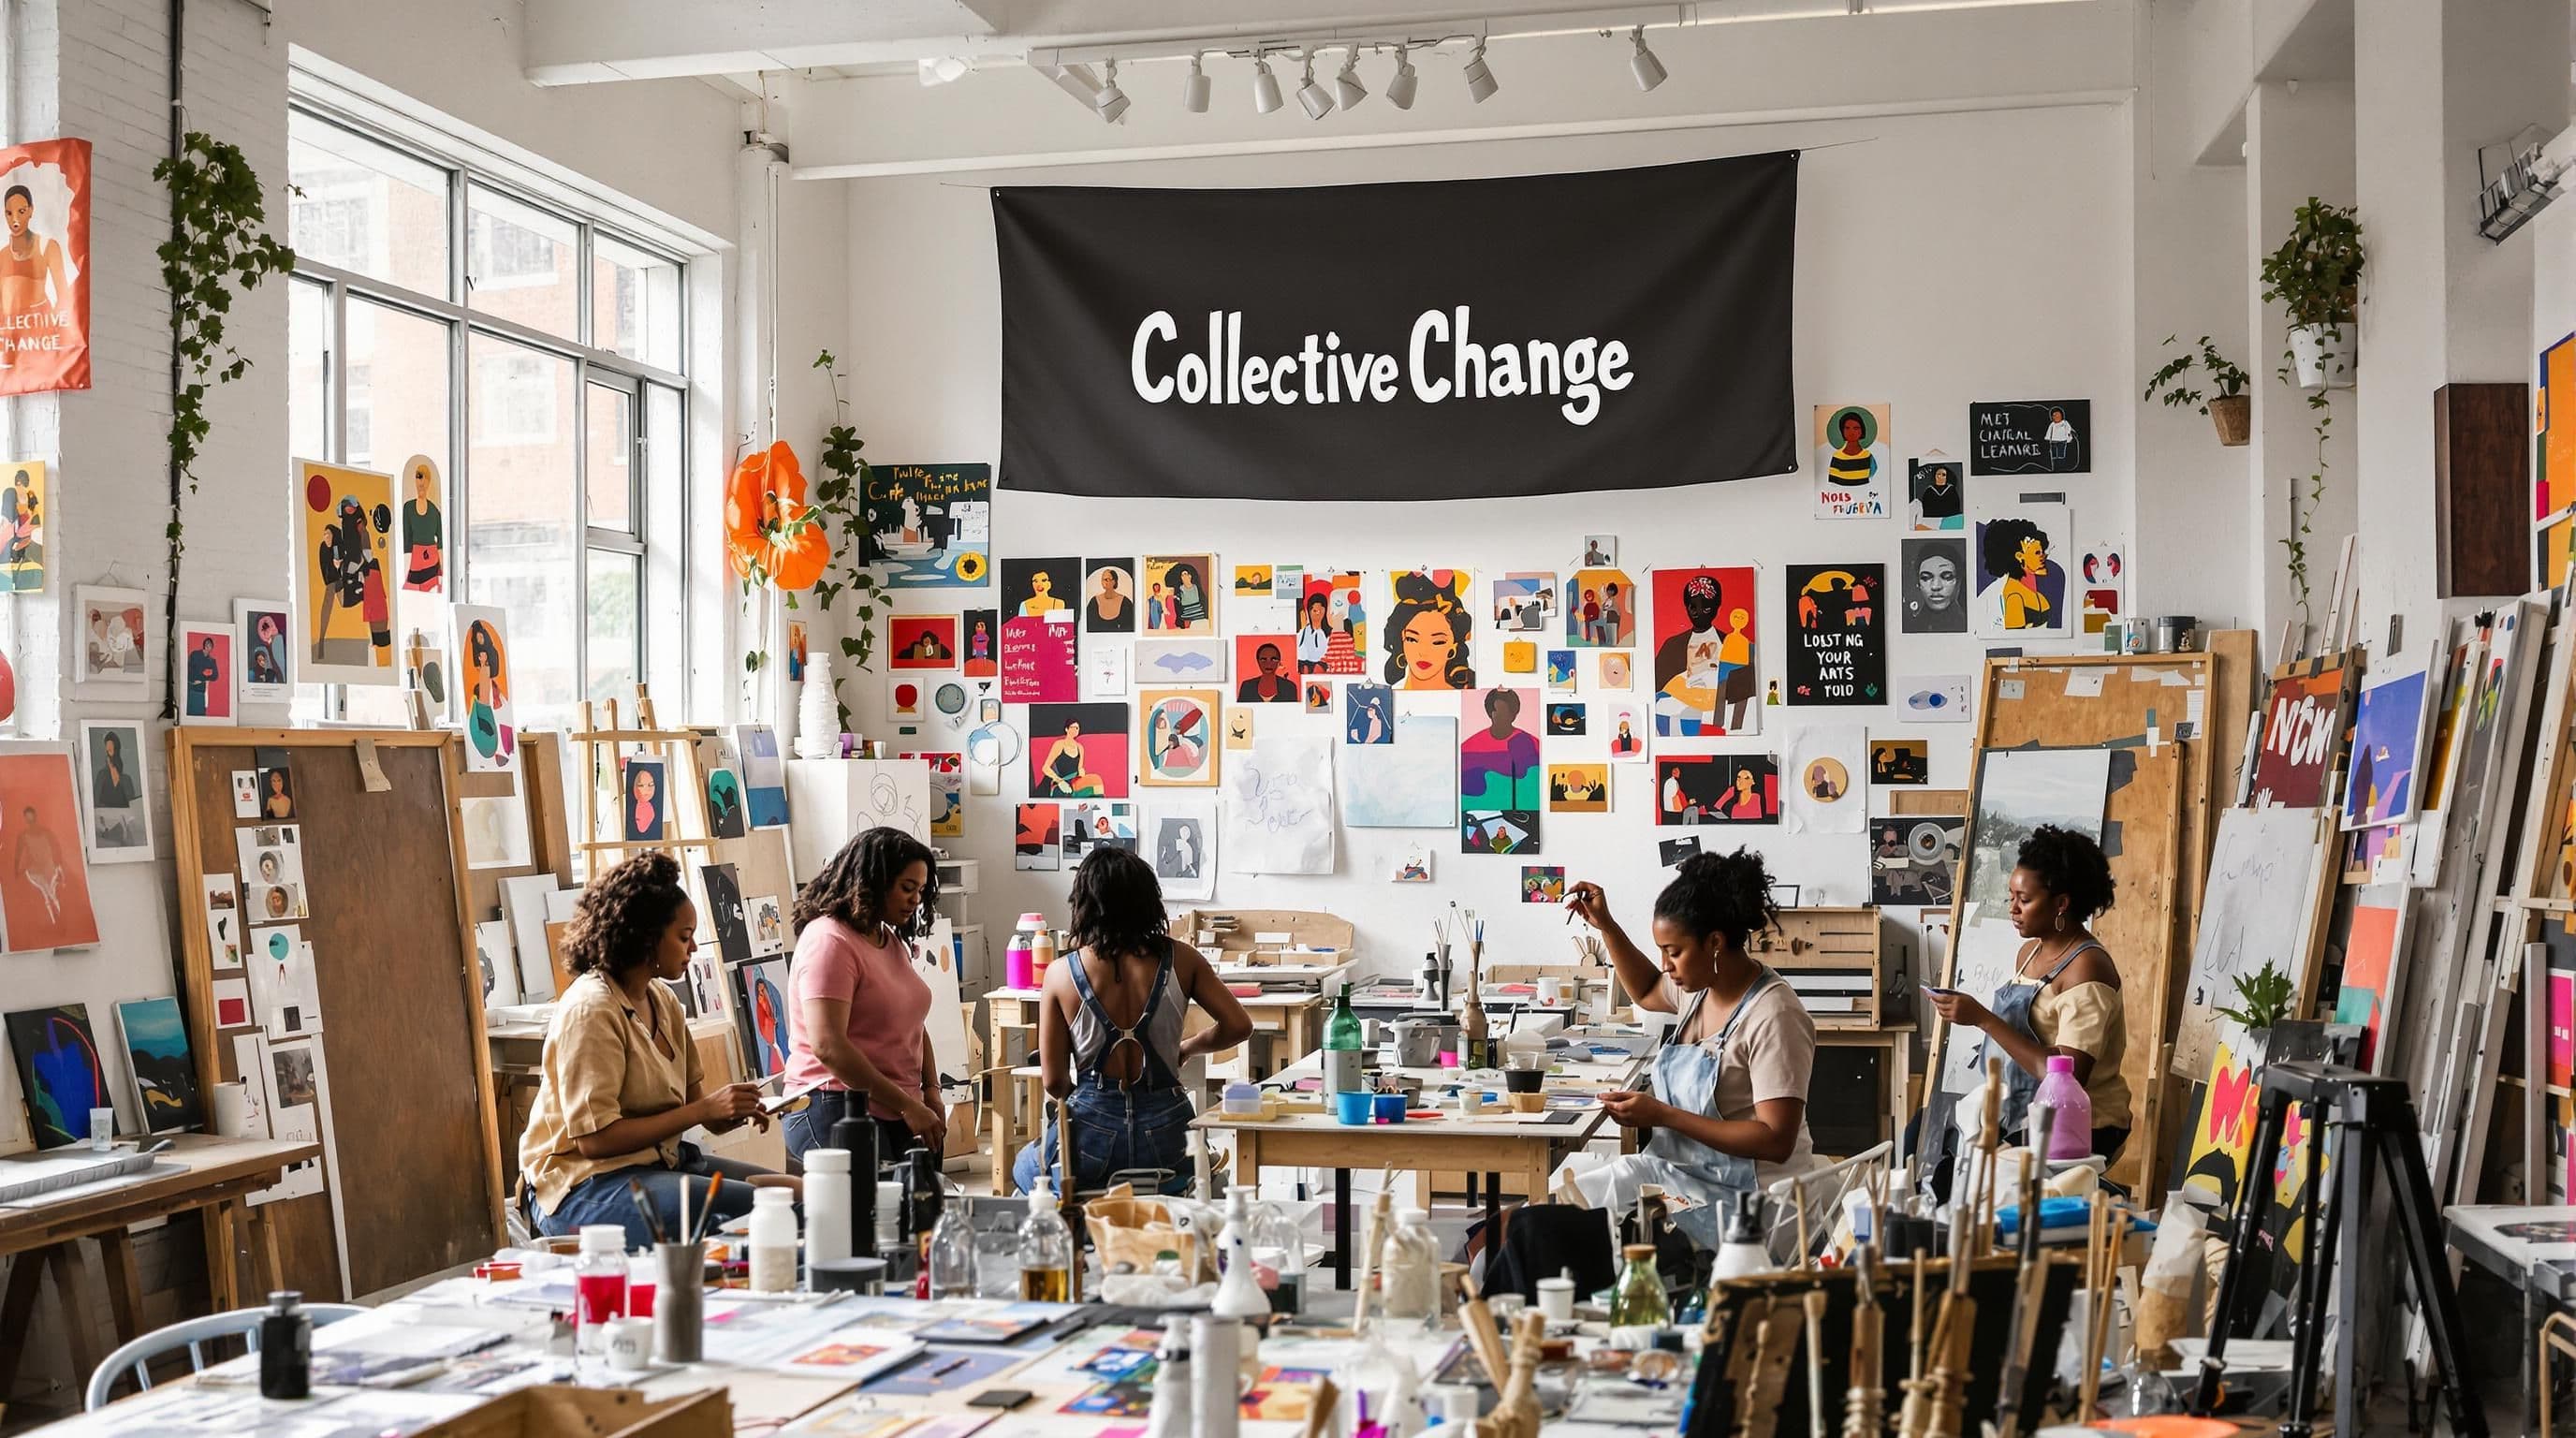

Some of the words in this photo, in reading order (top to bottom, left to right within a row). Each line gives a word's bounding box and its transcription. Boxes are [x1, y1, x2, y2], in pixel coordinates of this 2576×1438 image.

[1131, 310, 1399, 404] Collective
[1409, 305, 1633, 425] Change
[1816, 651, 1852, 665] YOUR
